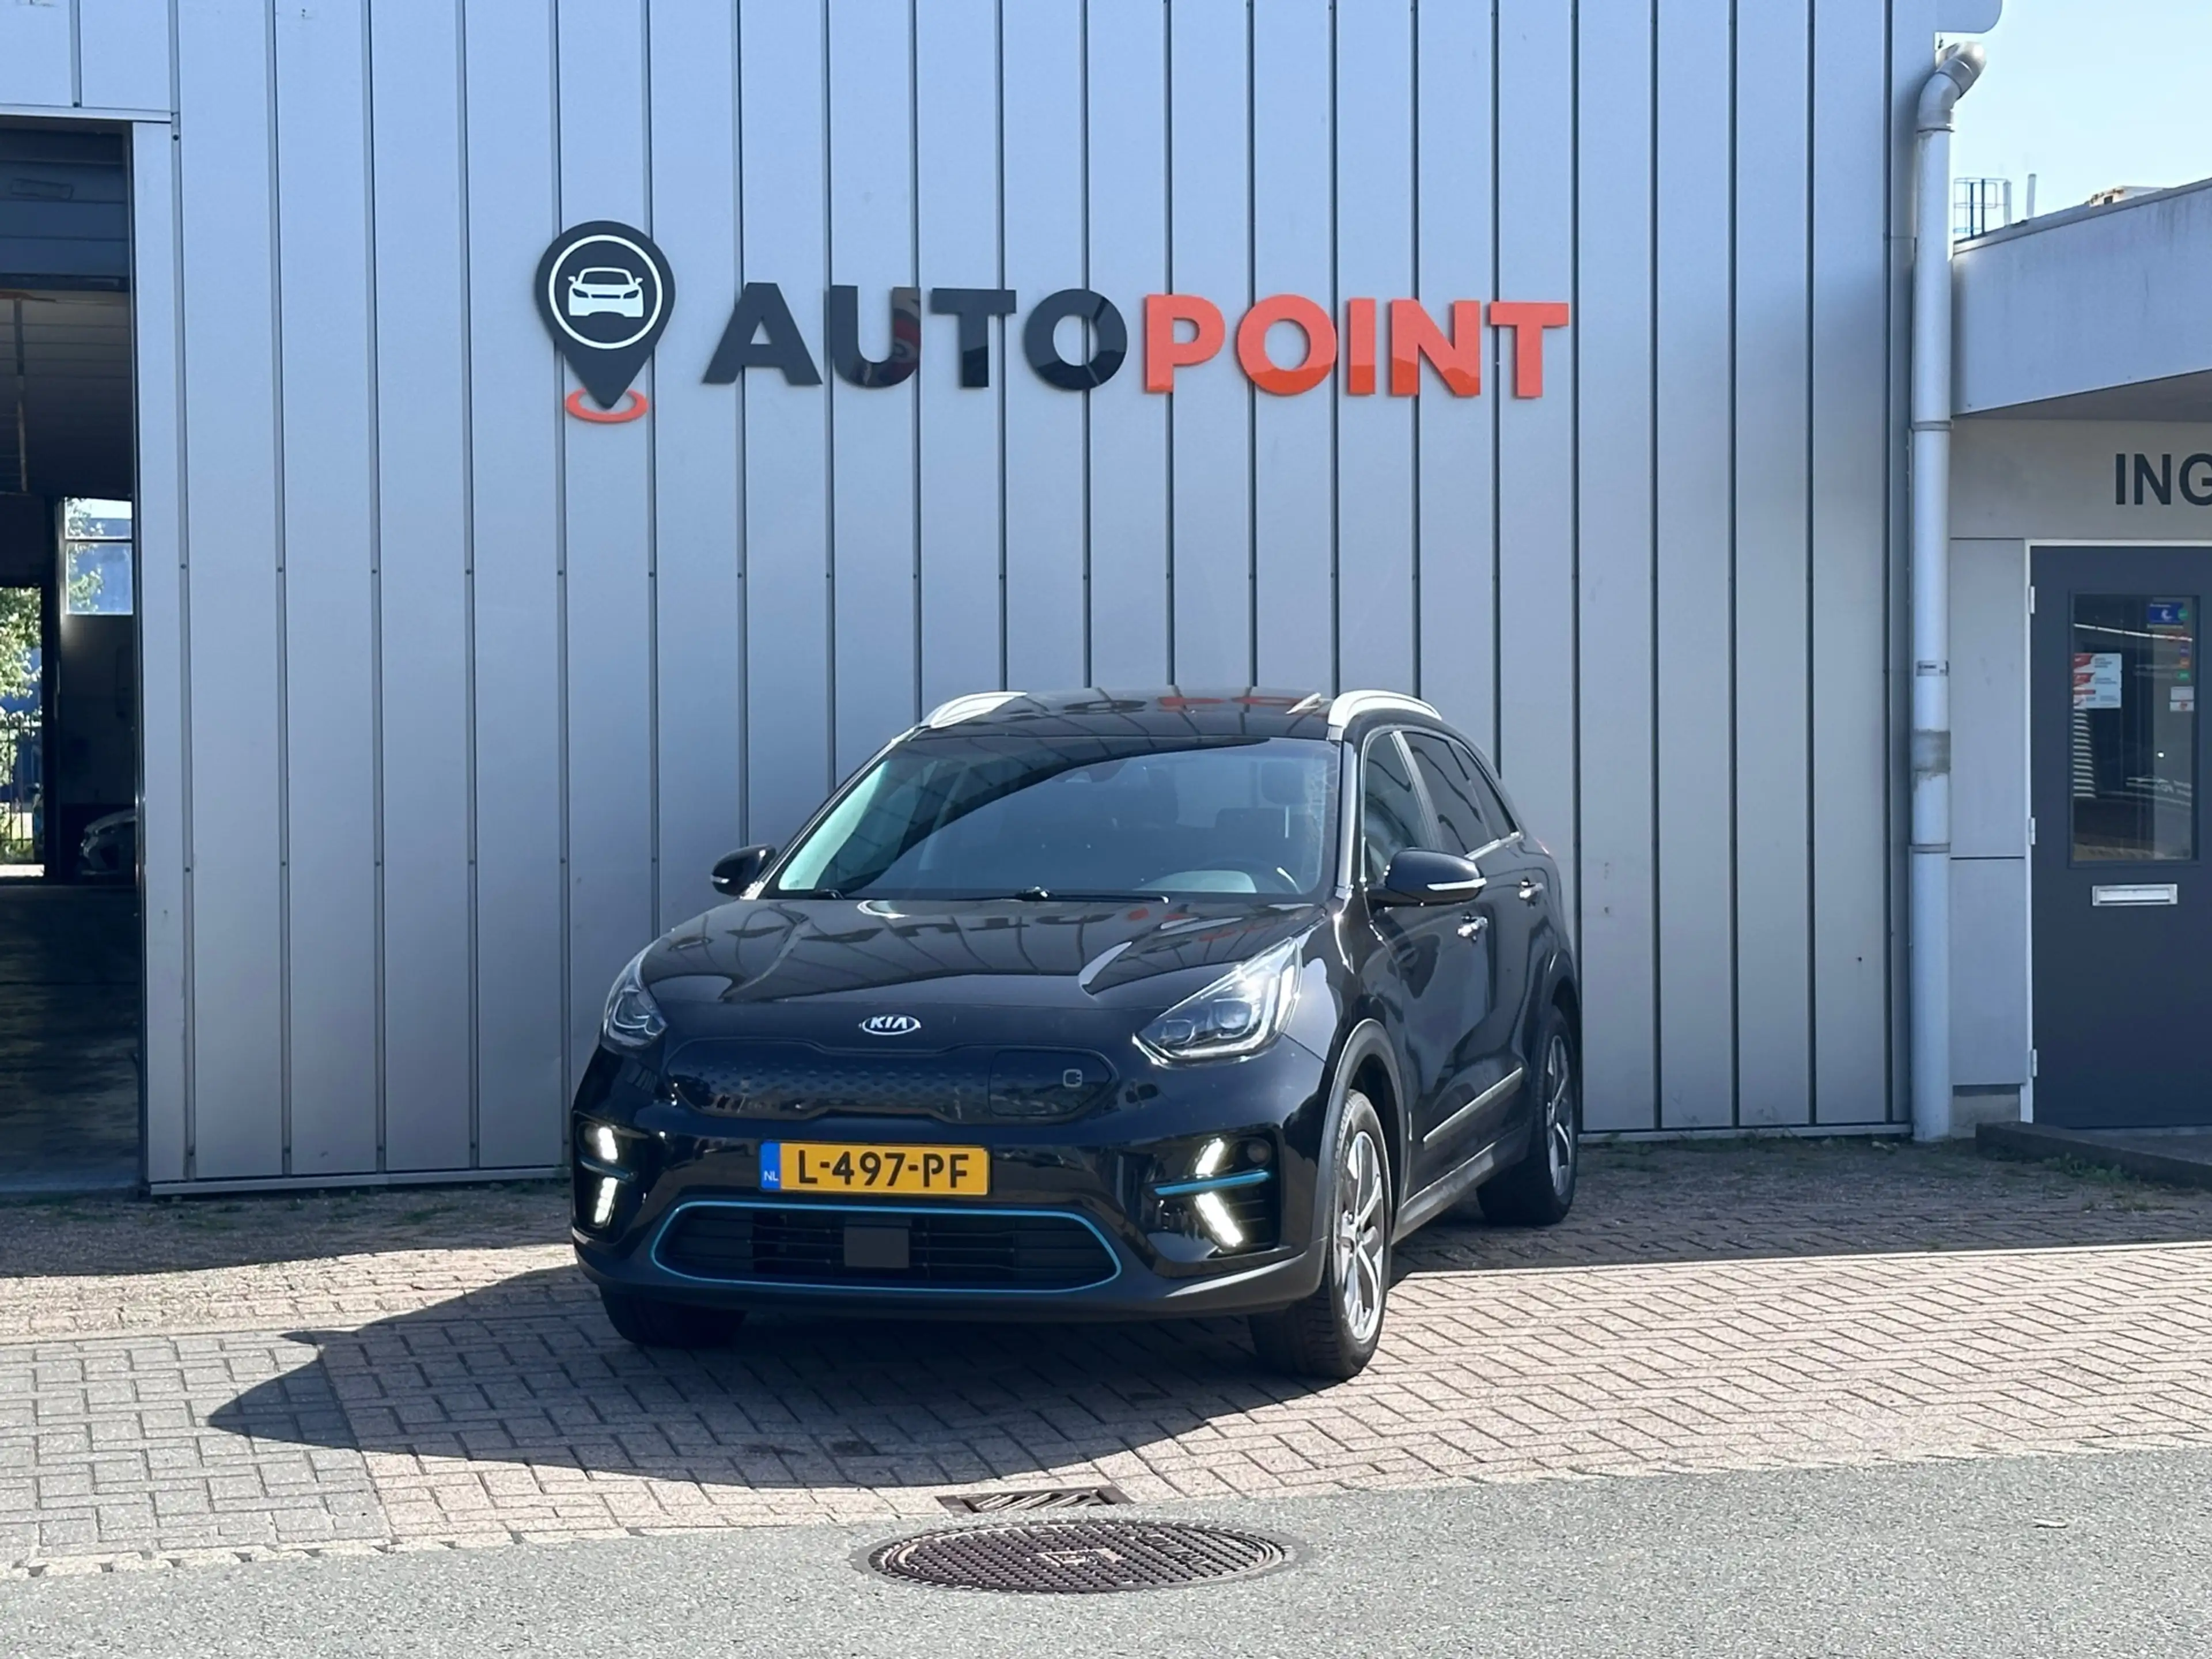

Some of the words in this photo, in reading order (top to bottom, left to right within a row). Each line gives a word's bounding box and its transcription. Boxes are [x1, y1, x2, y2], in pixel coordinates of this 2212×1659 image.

[700, 281, 1569, 398] AUTOPOINT
[870, 1016, 908, 1029] KIA
[764, 1170, 779, 1181] NL
[798, 1150, 969, 1188] L-497-PF
